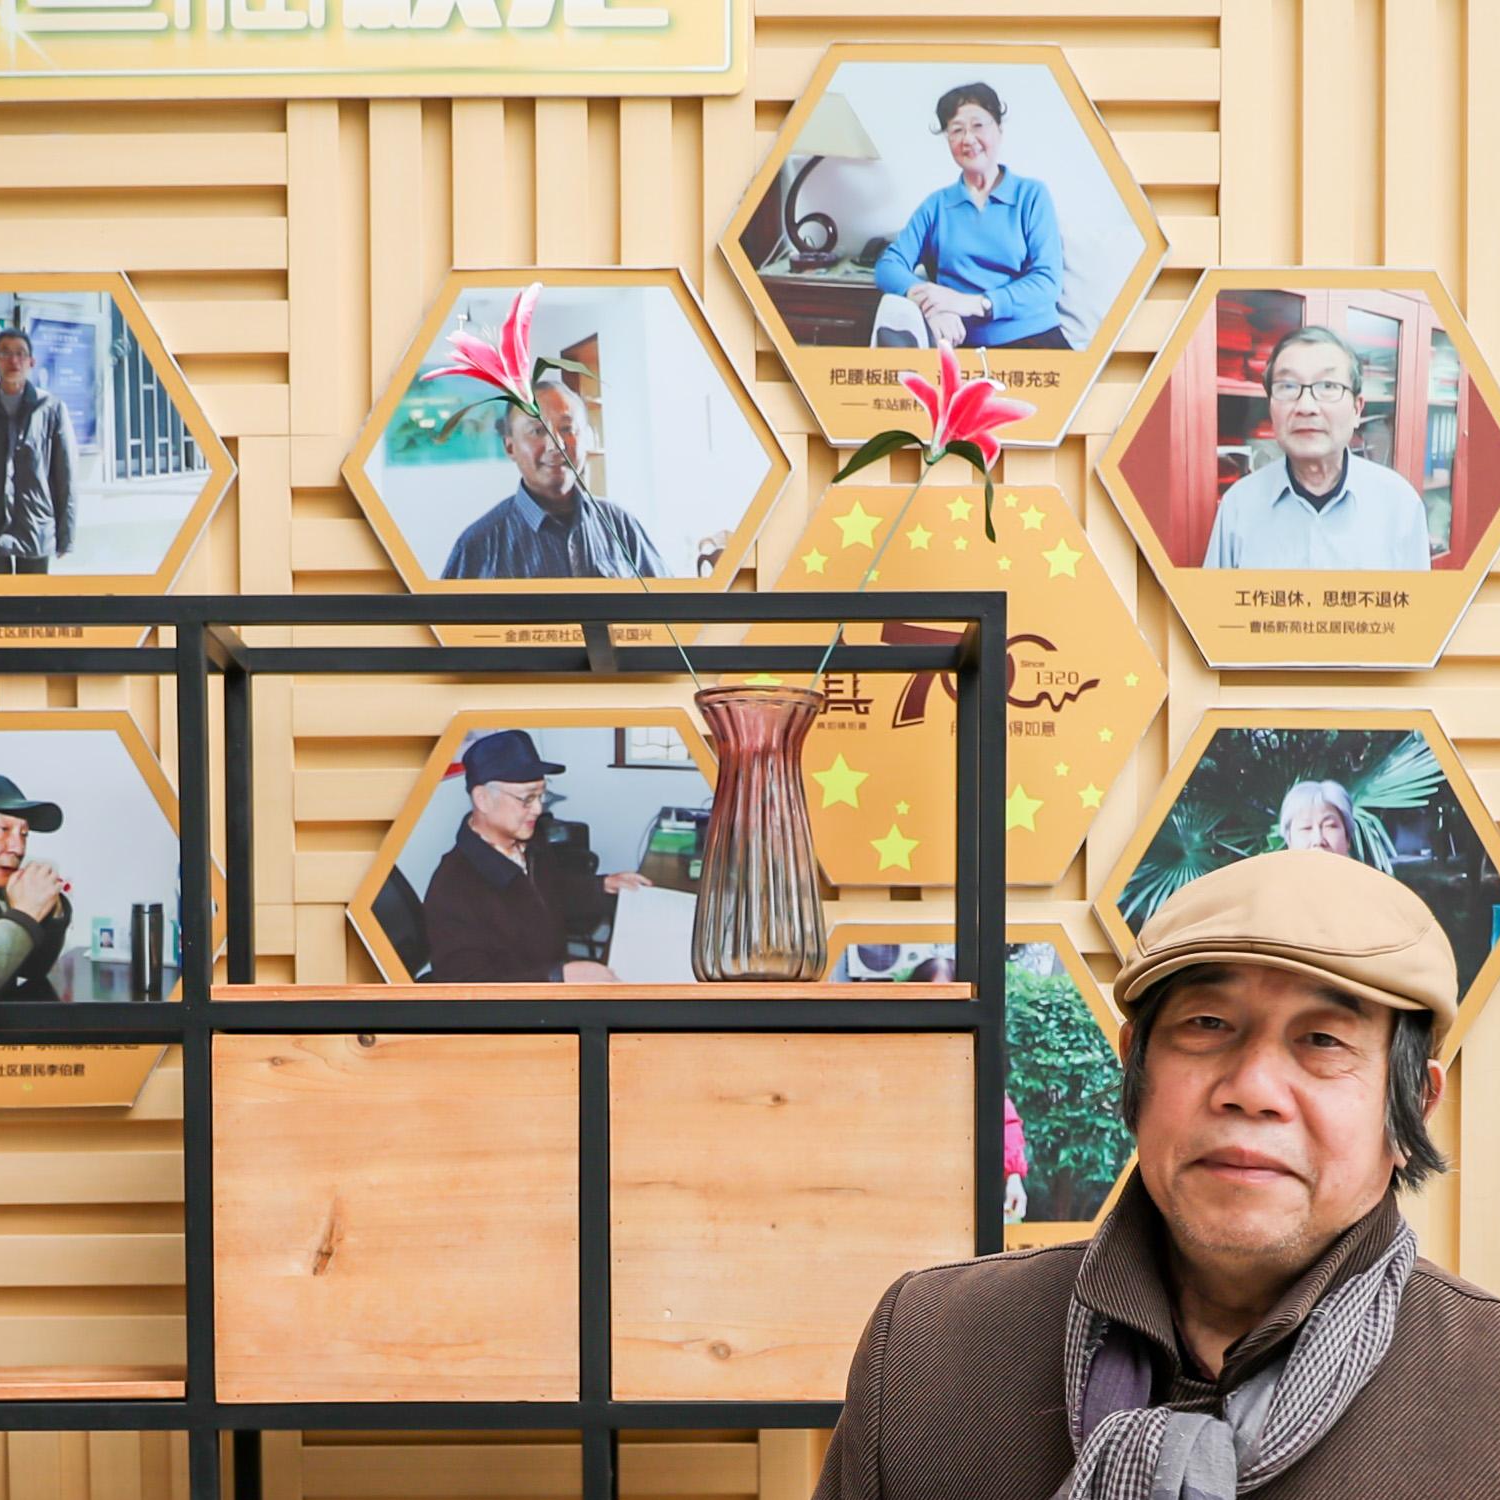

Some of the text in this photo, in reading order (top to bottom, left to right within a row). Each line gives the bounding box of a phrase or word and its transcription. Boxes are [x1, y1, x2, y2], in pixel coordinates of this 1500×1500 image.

[1234, 590, 1410, 608] 工作退休，思想不退休
[1036, 672, 1080, 685] 1320
